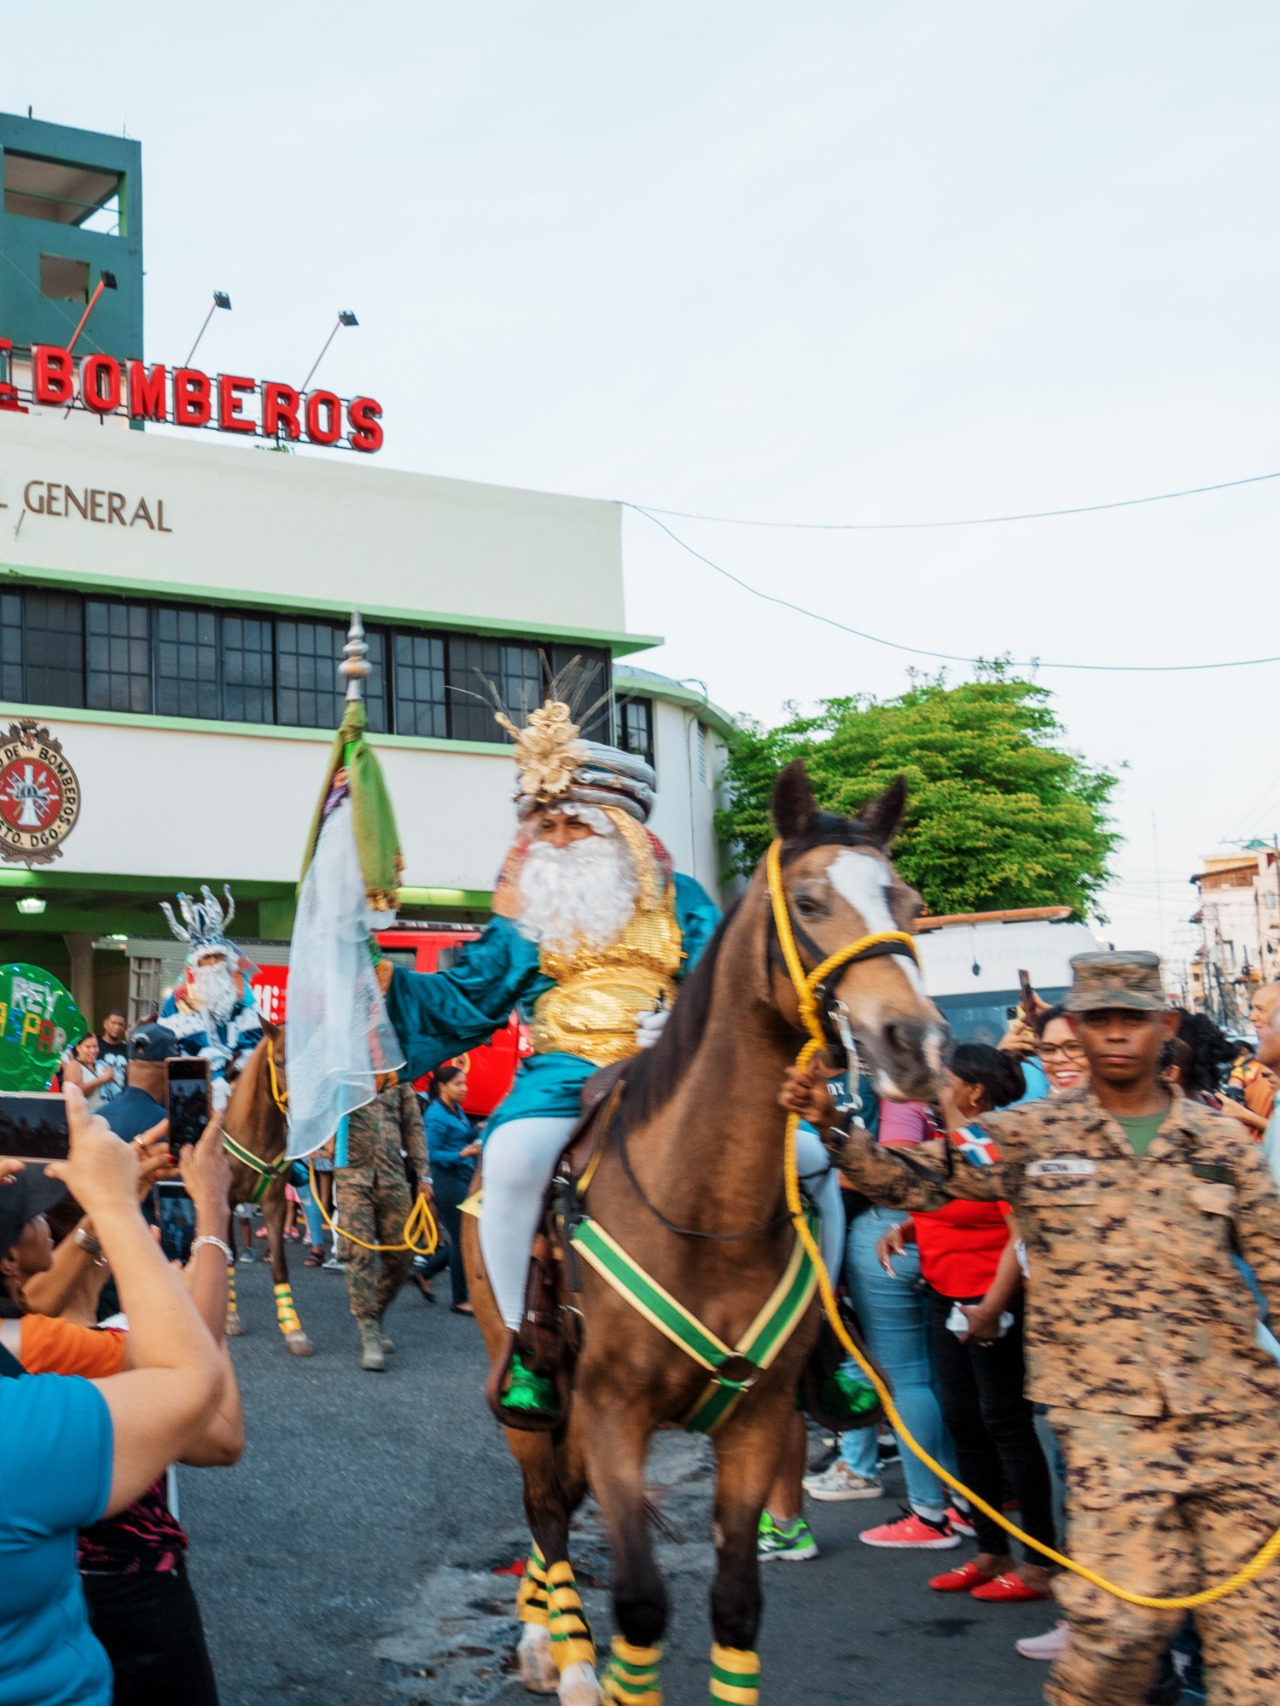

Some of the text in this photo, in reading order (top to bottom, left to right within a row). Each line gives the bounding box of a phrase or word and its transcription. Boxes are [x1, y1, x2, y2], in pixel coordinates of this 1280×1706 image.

[31, 342, 384, 453] BOMBEROS
[23, 480, 173, 533] GENERAL
[4, 744, 21, 761] DE
[38, 747, 77, 826] BOMBEROS
[10, 976, 59, 1020] REY
